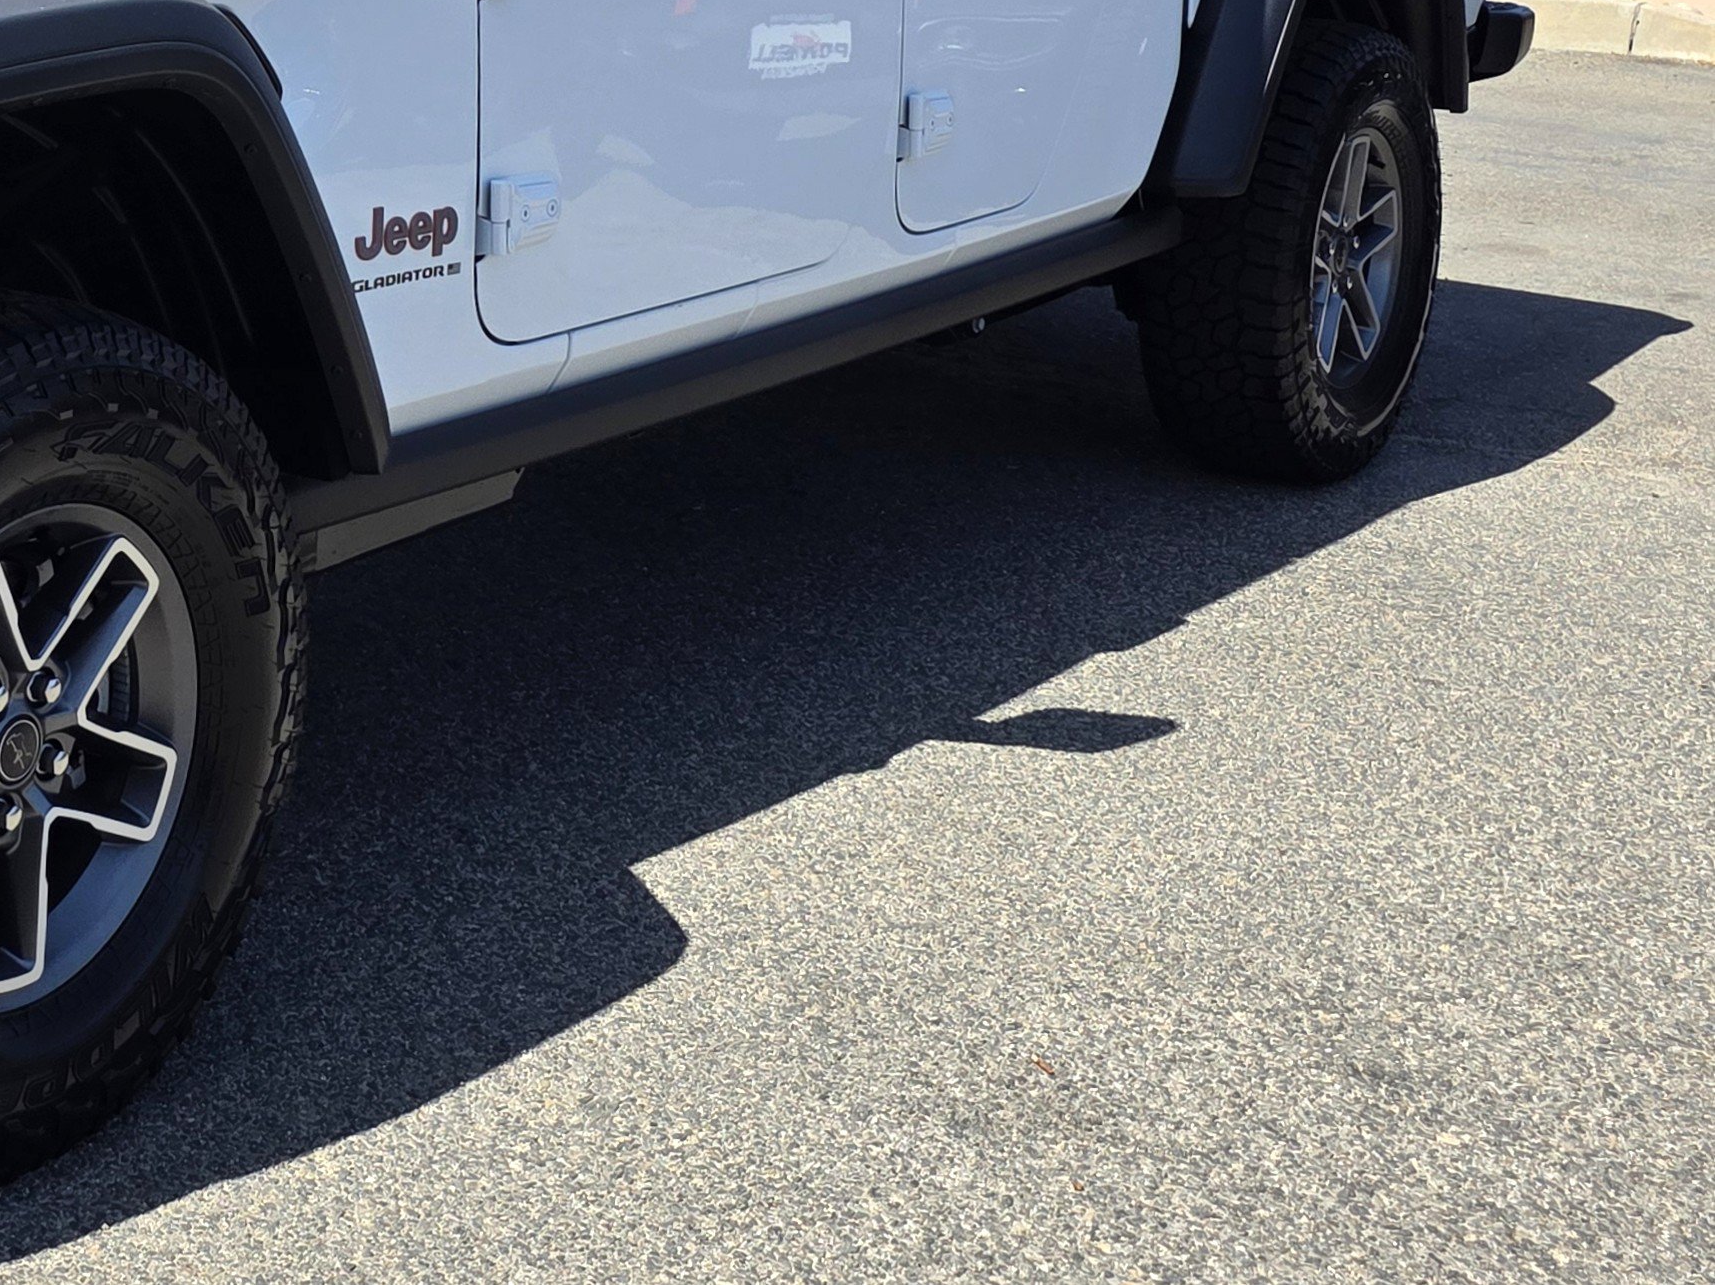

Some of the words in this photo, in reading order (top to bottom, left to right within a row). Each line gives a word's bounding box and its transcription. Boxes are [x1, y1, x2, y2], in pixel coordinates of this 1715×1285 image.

[354, 206, 459, 262] Jeep
[351, 265, 445, 293] GLADIATOR
[50, 417, 271, 618] FALKEN
